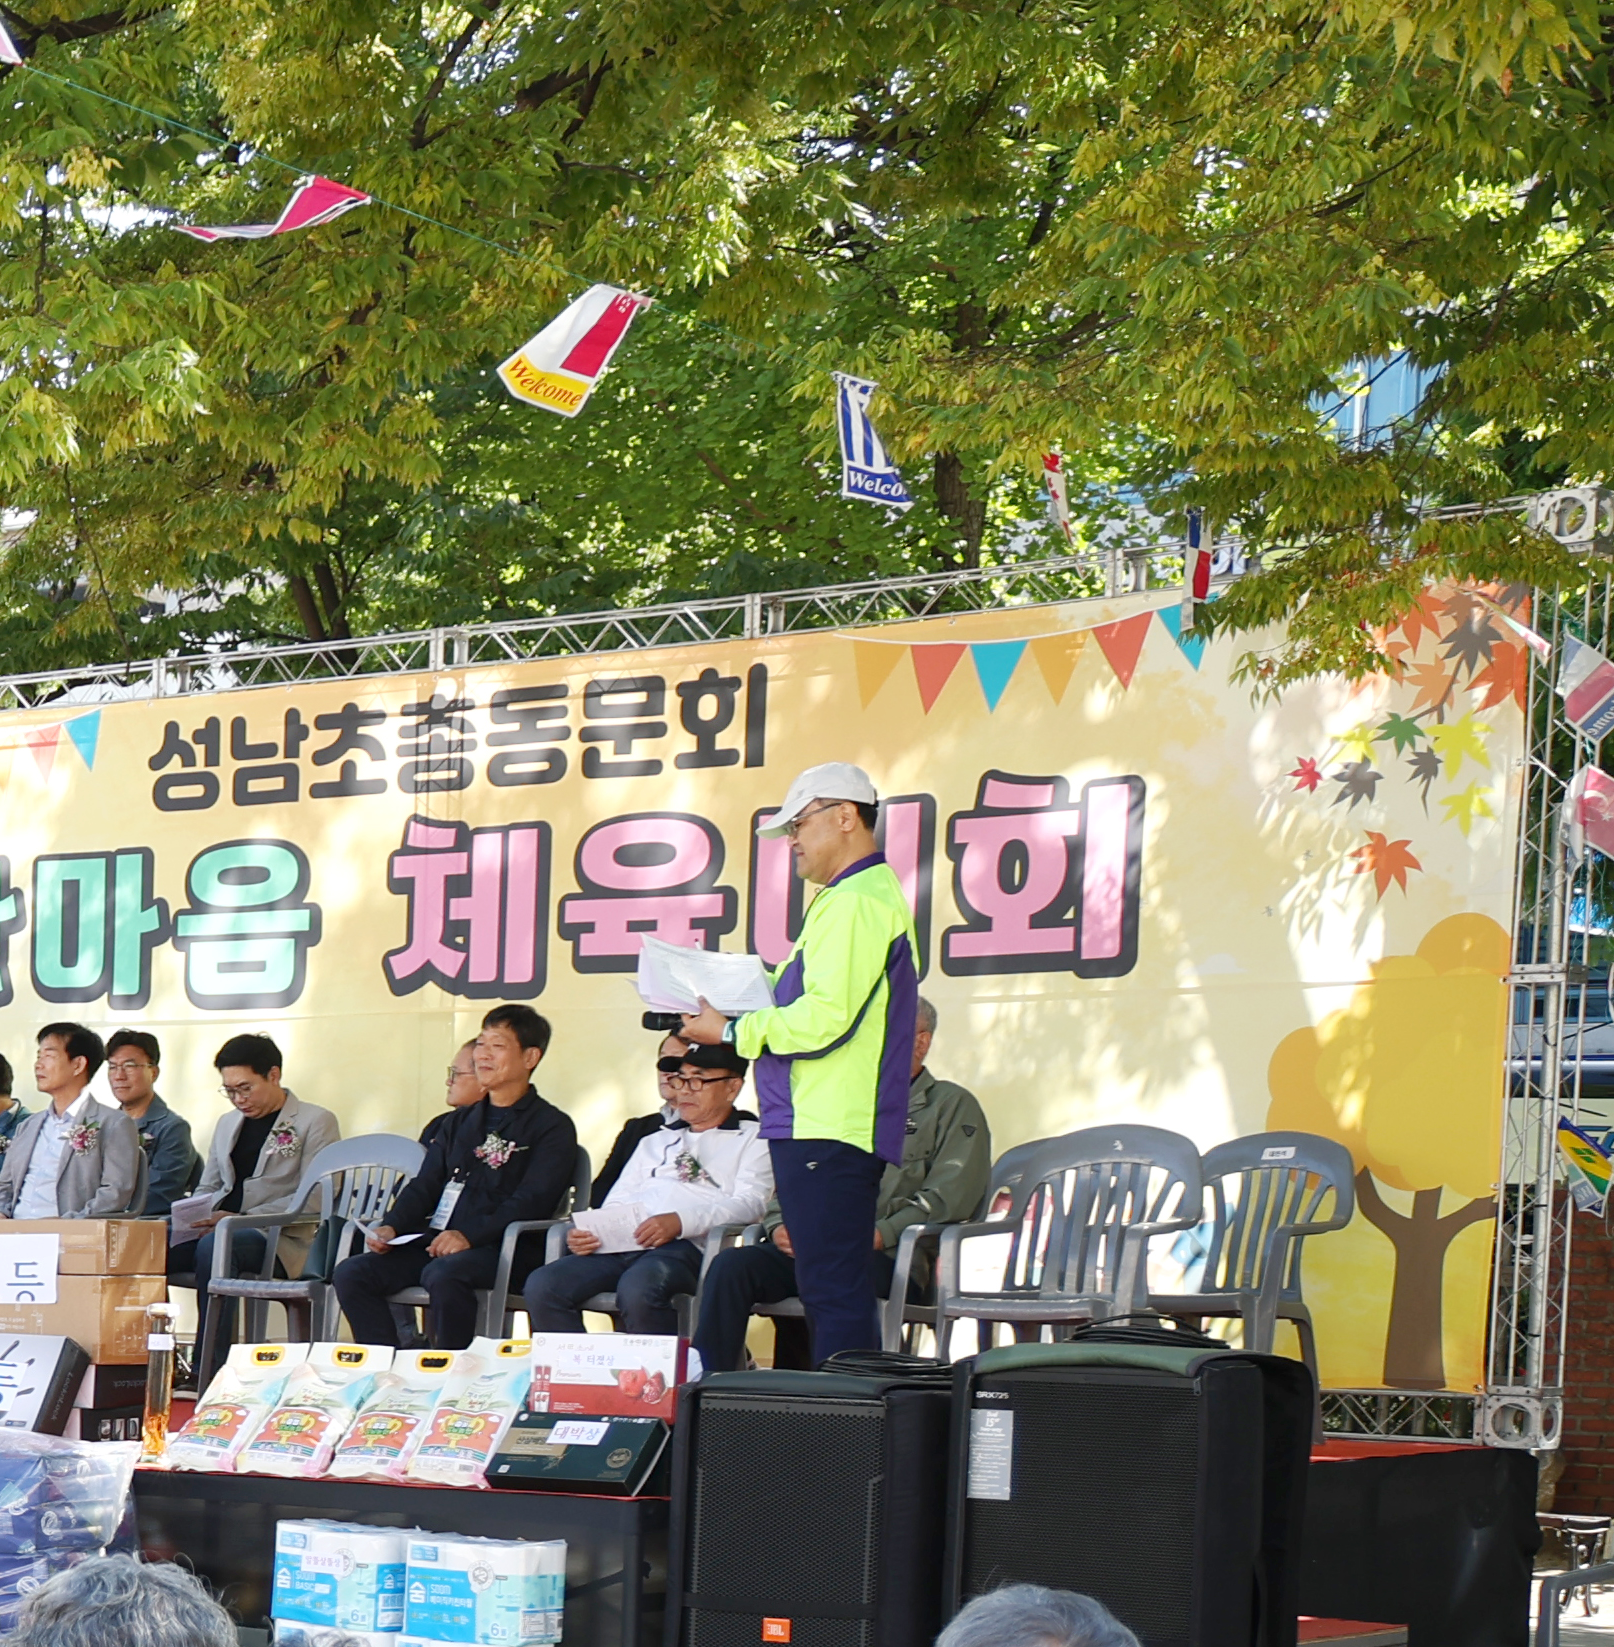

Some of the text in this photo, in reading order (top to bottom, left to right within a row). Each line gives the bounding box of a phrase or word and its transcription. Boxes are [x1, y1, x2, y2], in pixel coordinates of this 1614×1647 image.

[510, 359, 584, 407] Welcome
[848, 469, 907, 497] Welco
[148, 663, 768, 812] 성남초총동문회
[975, 1390, 1010, 1399] SRX725
[554, 1425, 601, 1441] 대박상
[276, 1567, 292, 1589] 숨
[408, 1581, 426, 1604] 숨
[766, 1623, 785, 1636] JBL
